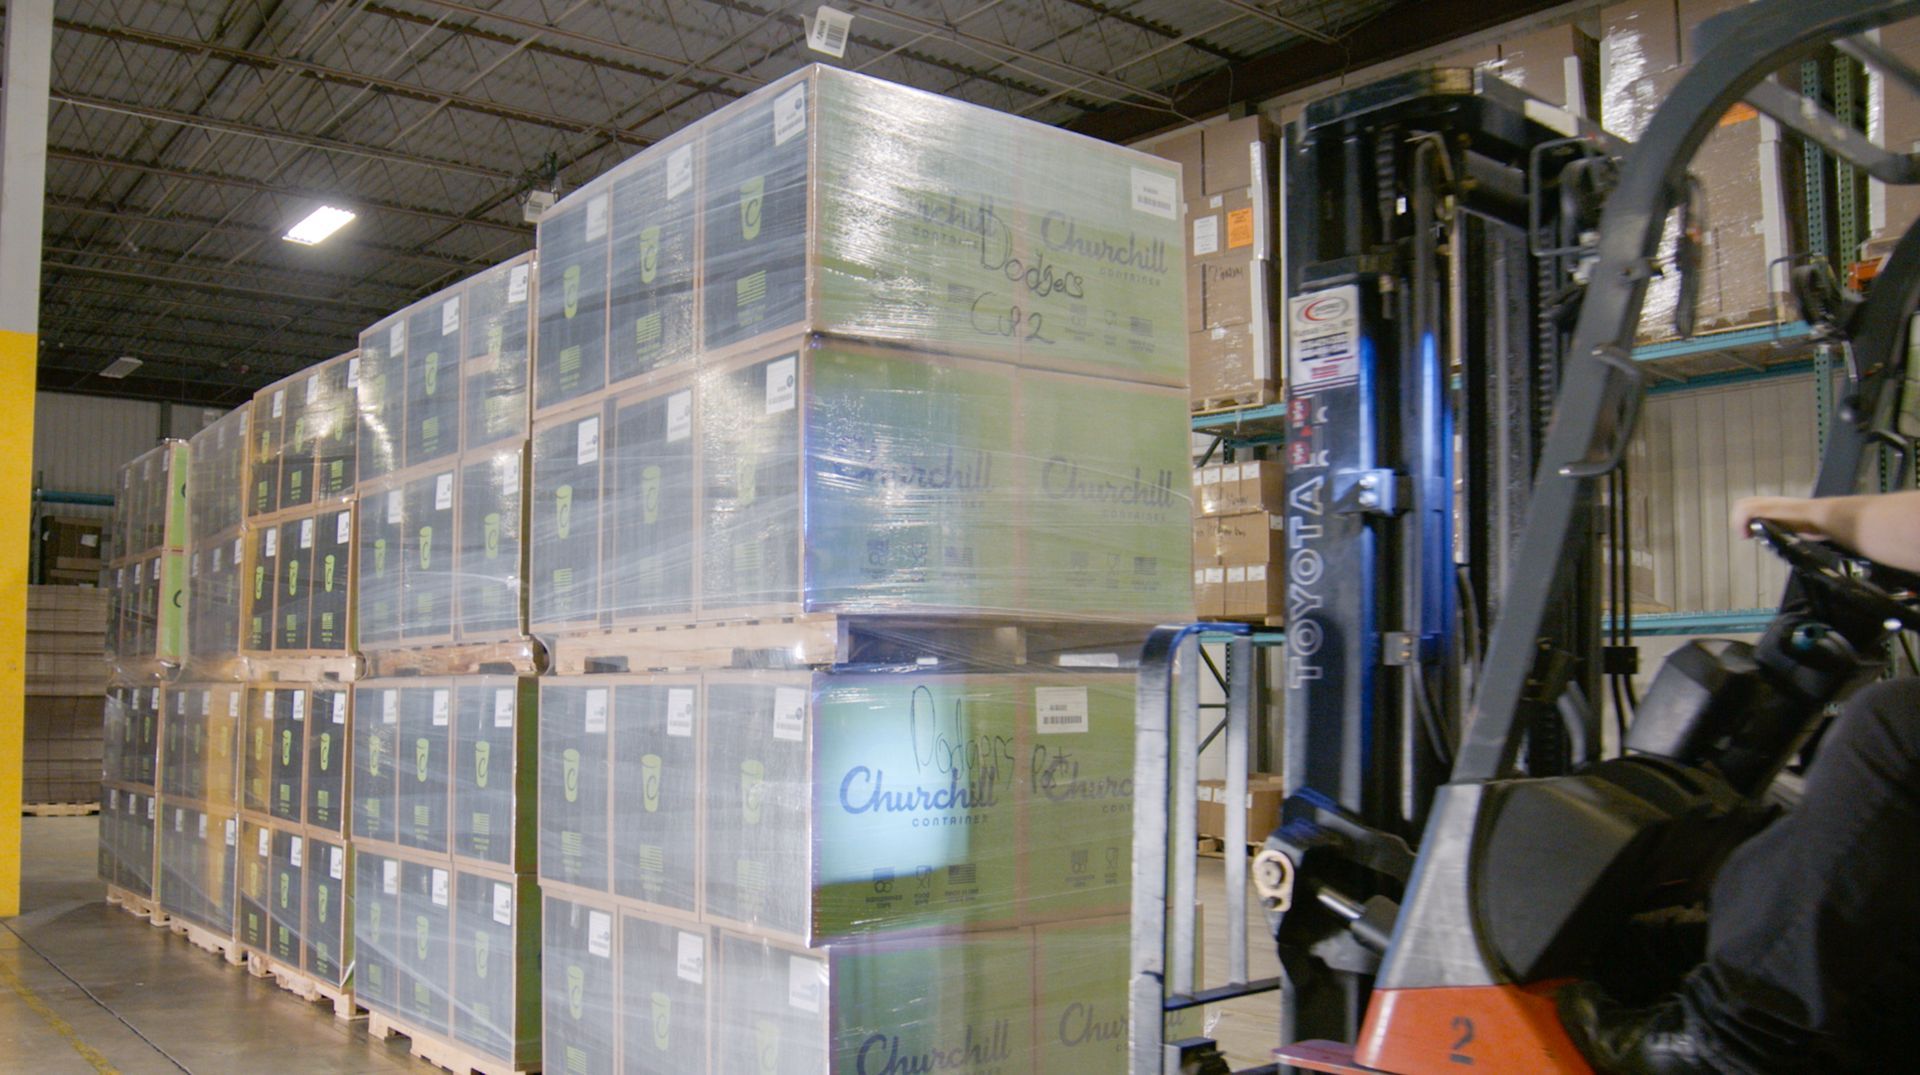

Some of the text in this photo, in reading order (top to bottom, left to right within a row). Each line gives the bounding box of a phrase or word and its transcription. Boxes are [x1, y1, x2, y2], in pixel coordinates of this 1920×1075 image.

[1040, 211, 1168, 274] Churchill
[1023, 311, 1056, 344] 2
[1041, 456, 1174, 509] Churchill
[1289, 475, 1324, 689] TOYOTA
[910, 685, 1014, 791] Dodgers
[839, 764, 998, 815] Churchill
[857, 1018, 1011, 1075] Churchill
[1450, 1015, 1474, 1066] 2
